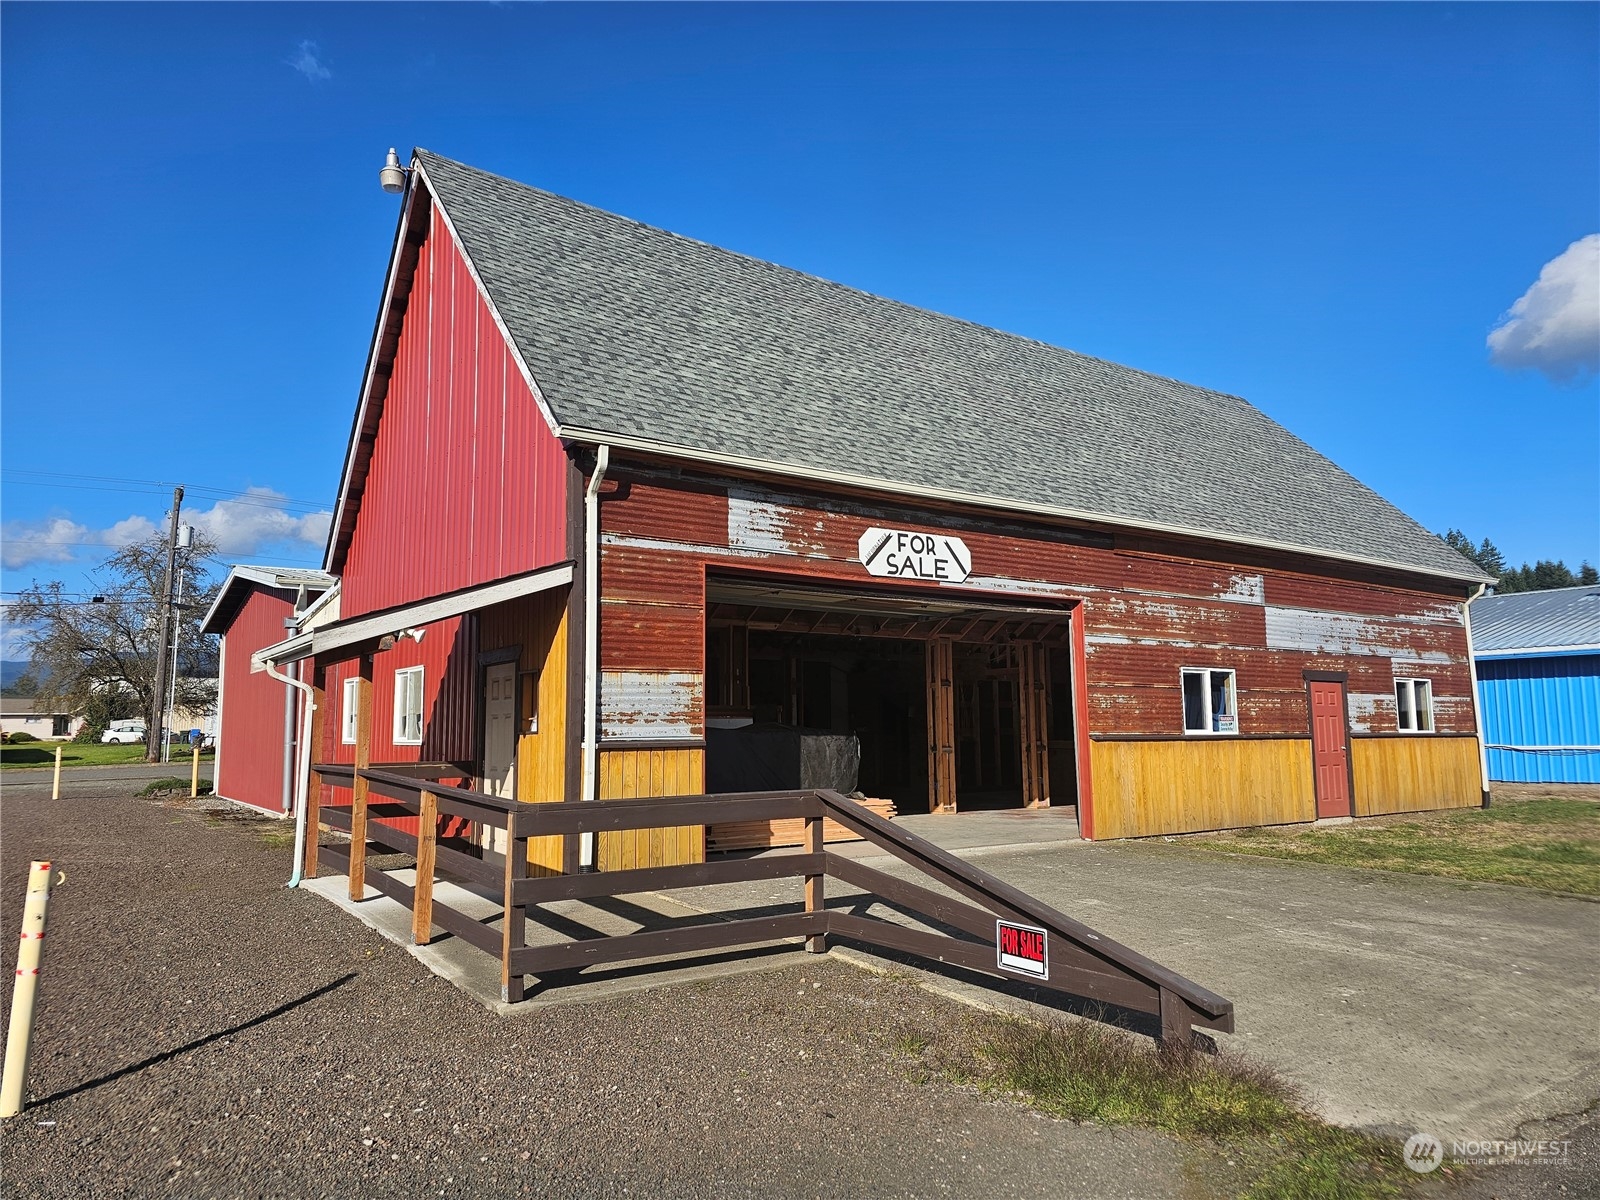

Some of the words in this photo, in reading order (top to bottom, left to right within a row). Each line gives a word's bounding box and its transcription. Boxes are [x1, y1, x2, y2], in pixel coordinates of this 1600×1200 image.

[897, 533, 936, 555] FOR
[886, 553, 949, 579] SALE
[1001, 927, 1019, 955] FOR
[1020, 931, 1043, 961] SALE
